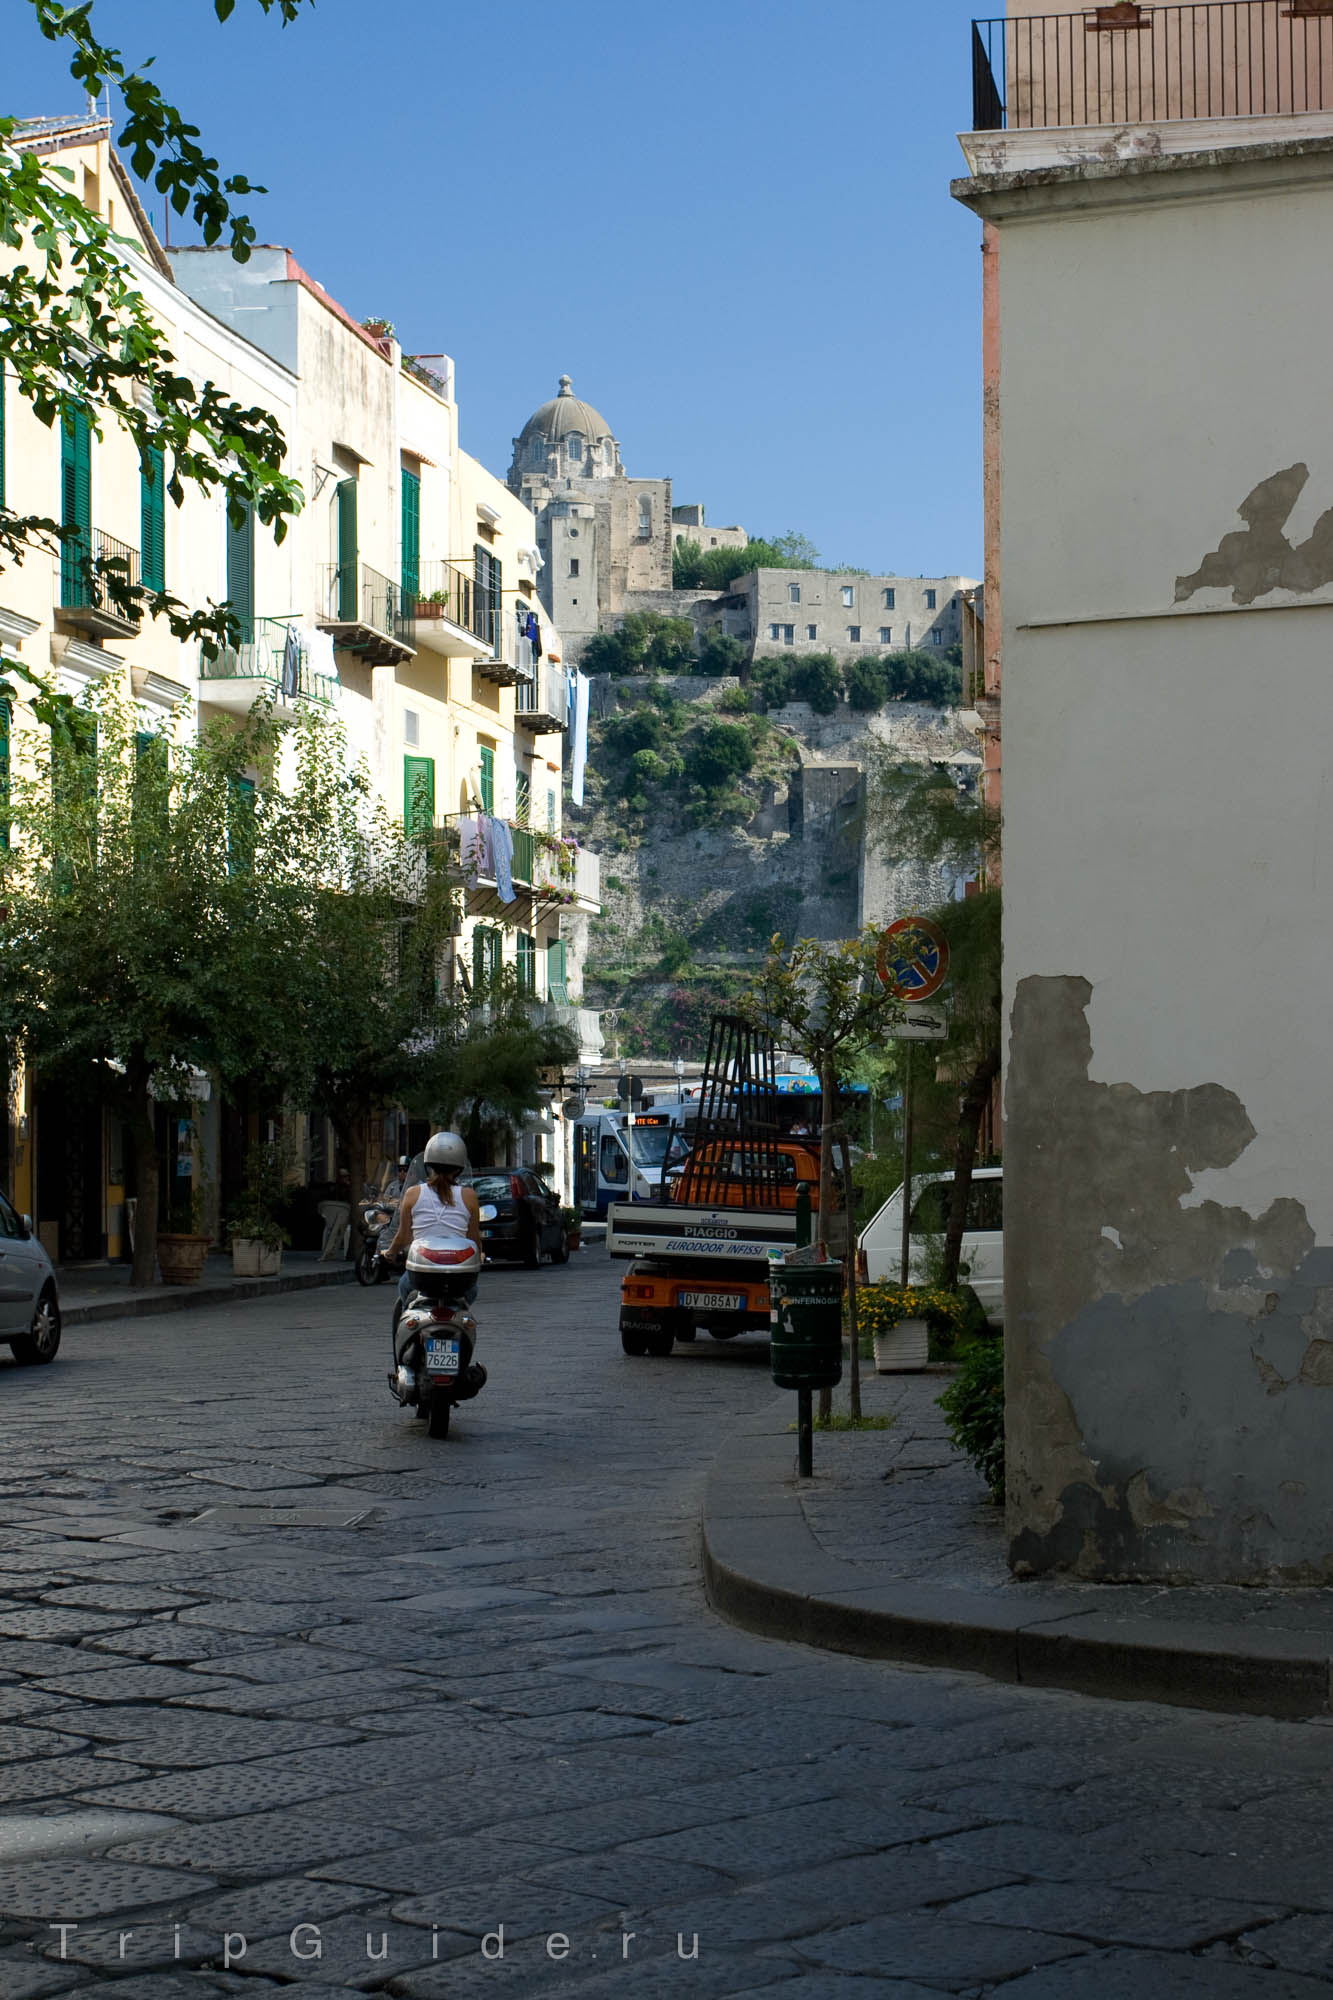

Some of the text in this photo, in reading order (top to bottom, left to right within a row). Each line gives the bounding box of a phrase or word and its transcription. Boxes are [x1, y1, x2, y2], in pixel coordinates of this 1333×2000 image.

[684, 1226, 738, 1239] PIAGGIO
[666, 1240, 724, 1254] EURODOOR
[685, 1294, 739, 1309] DV 085AY
[428, 1354, 457, 1366] 76226
